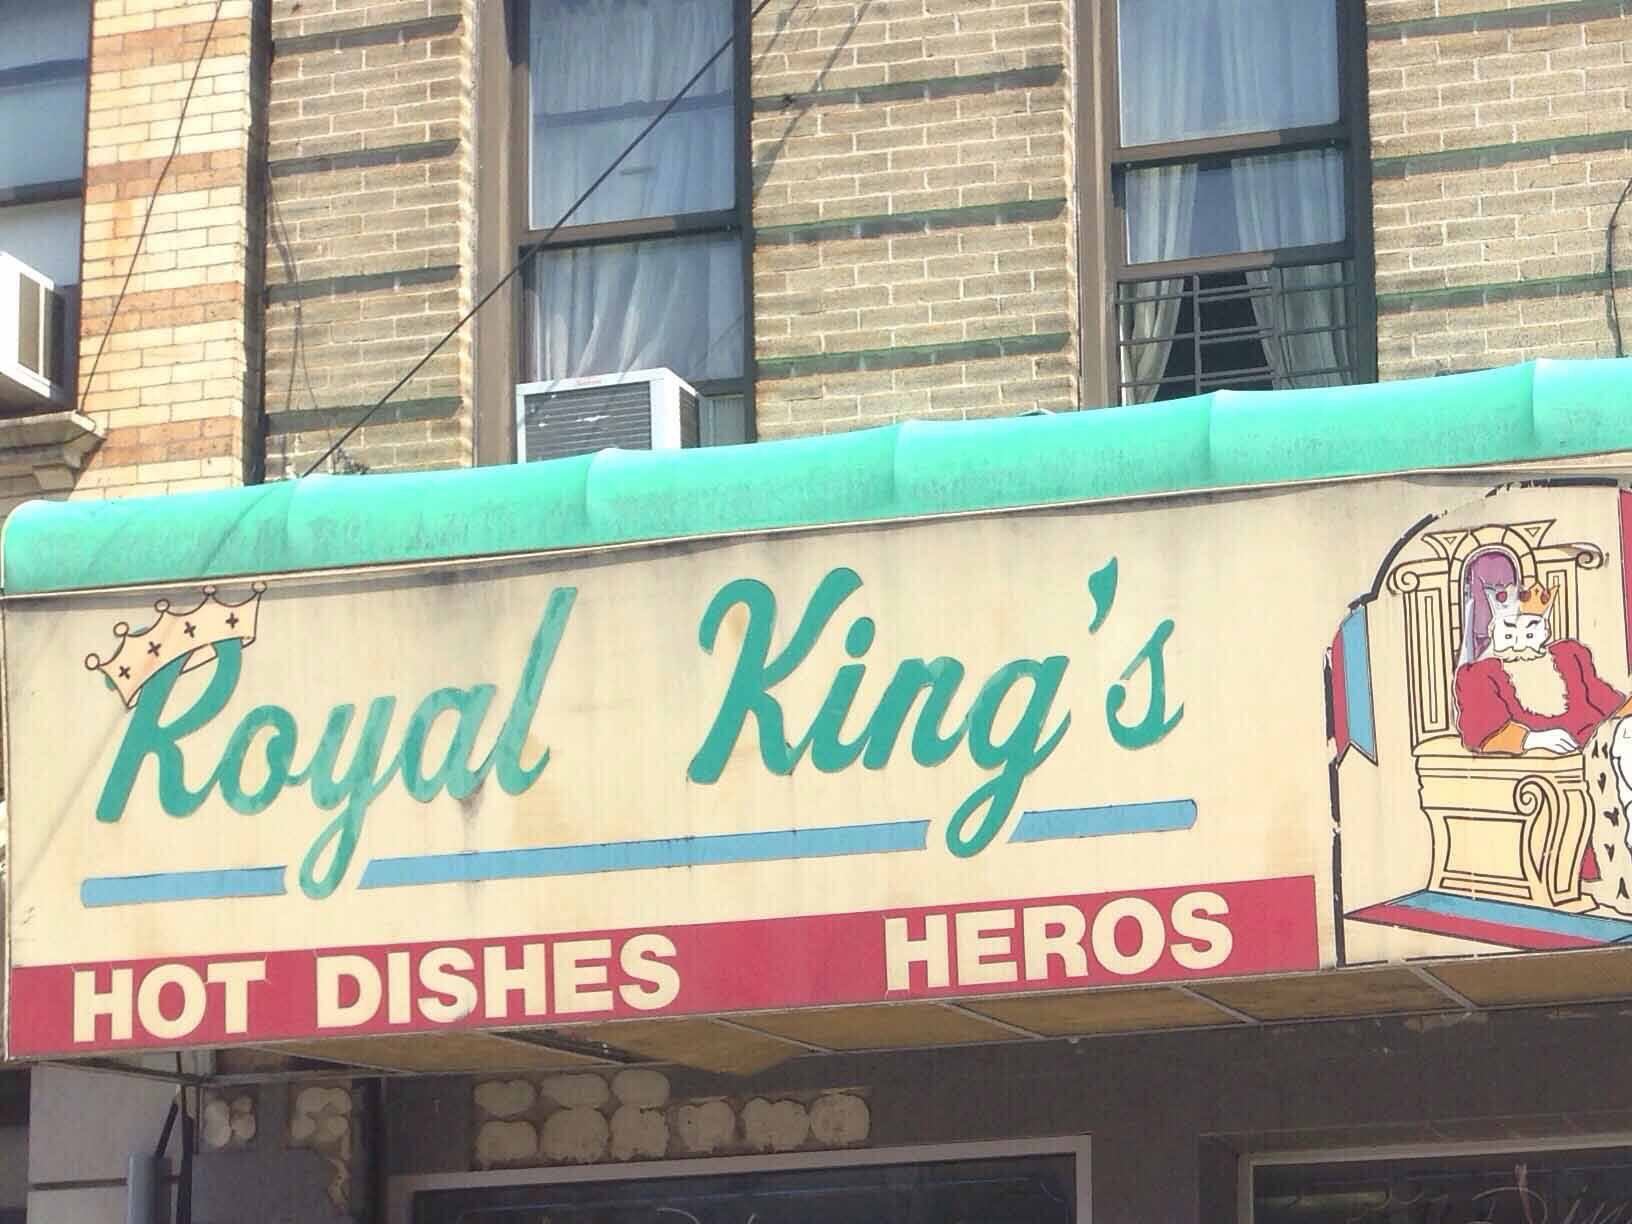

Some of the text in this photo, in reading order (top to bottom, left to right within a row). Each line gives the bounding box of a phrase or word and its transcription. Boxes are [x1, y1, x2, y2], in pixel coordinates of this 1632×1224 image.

[95, 556, 1185, 899] Royal King's
[72, 934, 681, 1043] HOT DISHES
[884, 891, 1233, 993] HEROS
